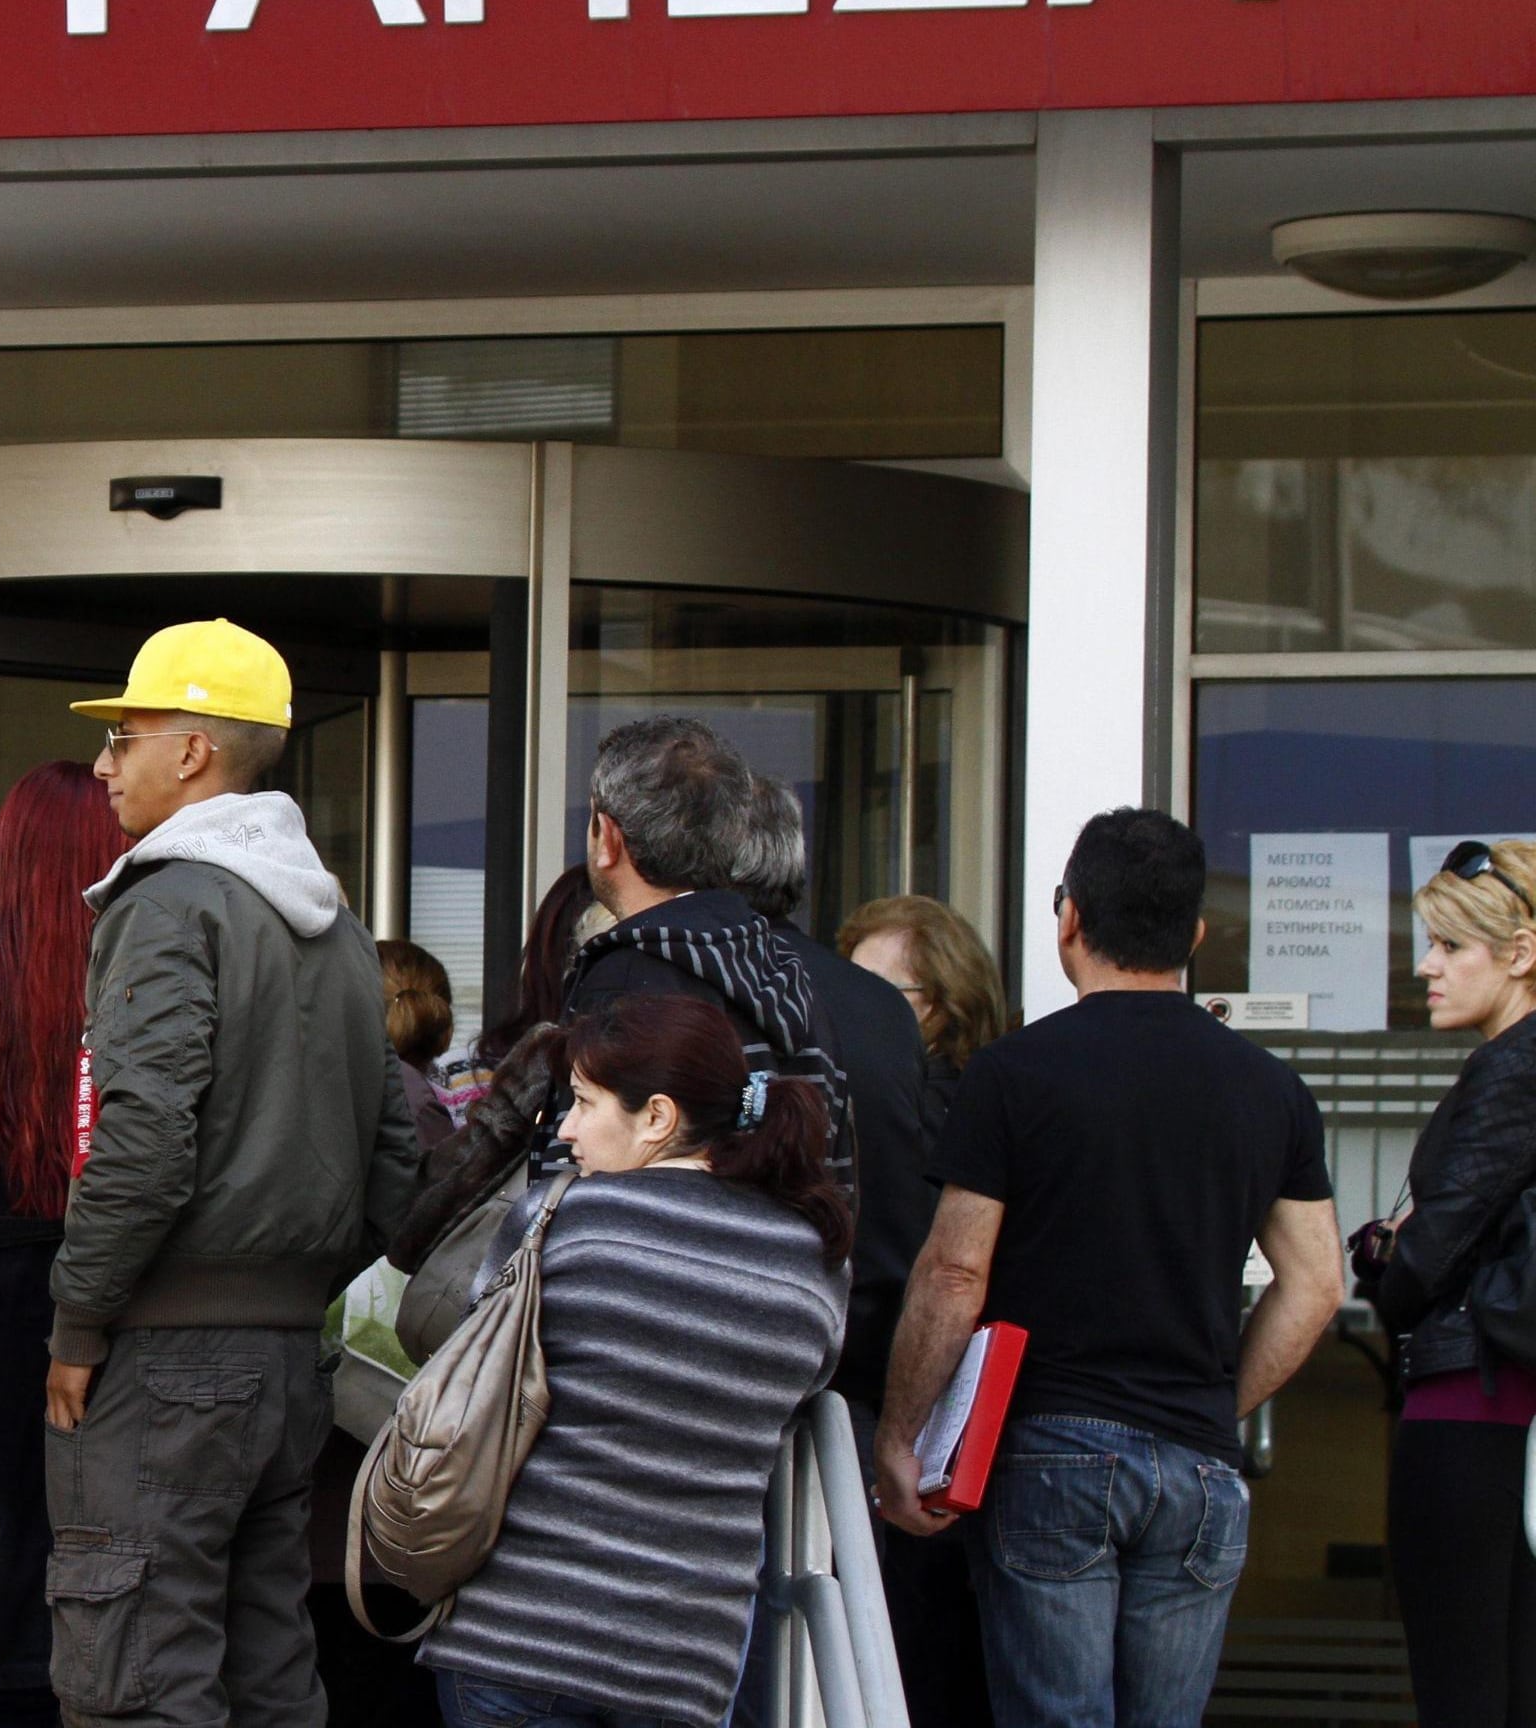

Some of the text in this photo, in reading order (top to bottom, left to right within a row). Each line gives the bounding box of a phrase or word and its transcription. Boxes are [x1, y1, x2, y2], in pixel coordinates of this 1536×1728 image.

[1267, 853, 1333, 865] ΜΕΓΙΣΤΟΣ
[1267, 876, 1331, 888] ΑΡΙΘΜΟΣ
[1267, 899, 1354, 911] ΑΤΟΜΩΝ ΓΙΑ
[1267, 922, 1362, 934] ΕΞΥΠΗΡΕΤΗΣΗ
[1266, 945, 1330, 957] 8 ΑΤΟΜΑ
